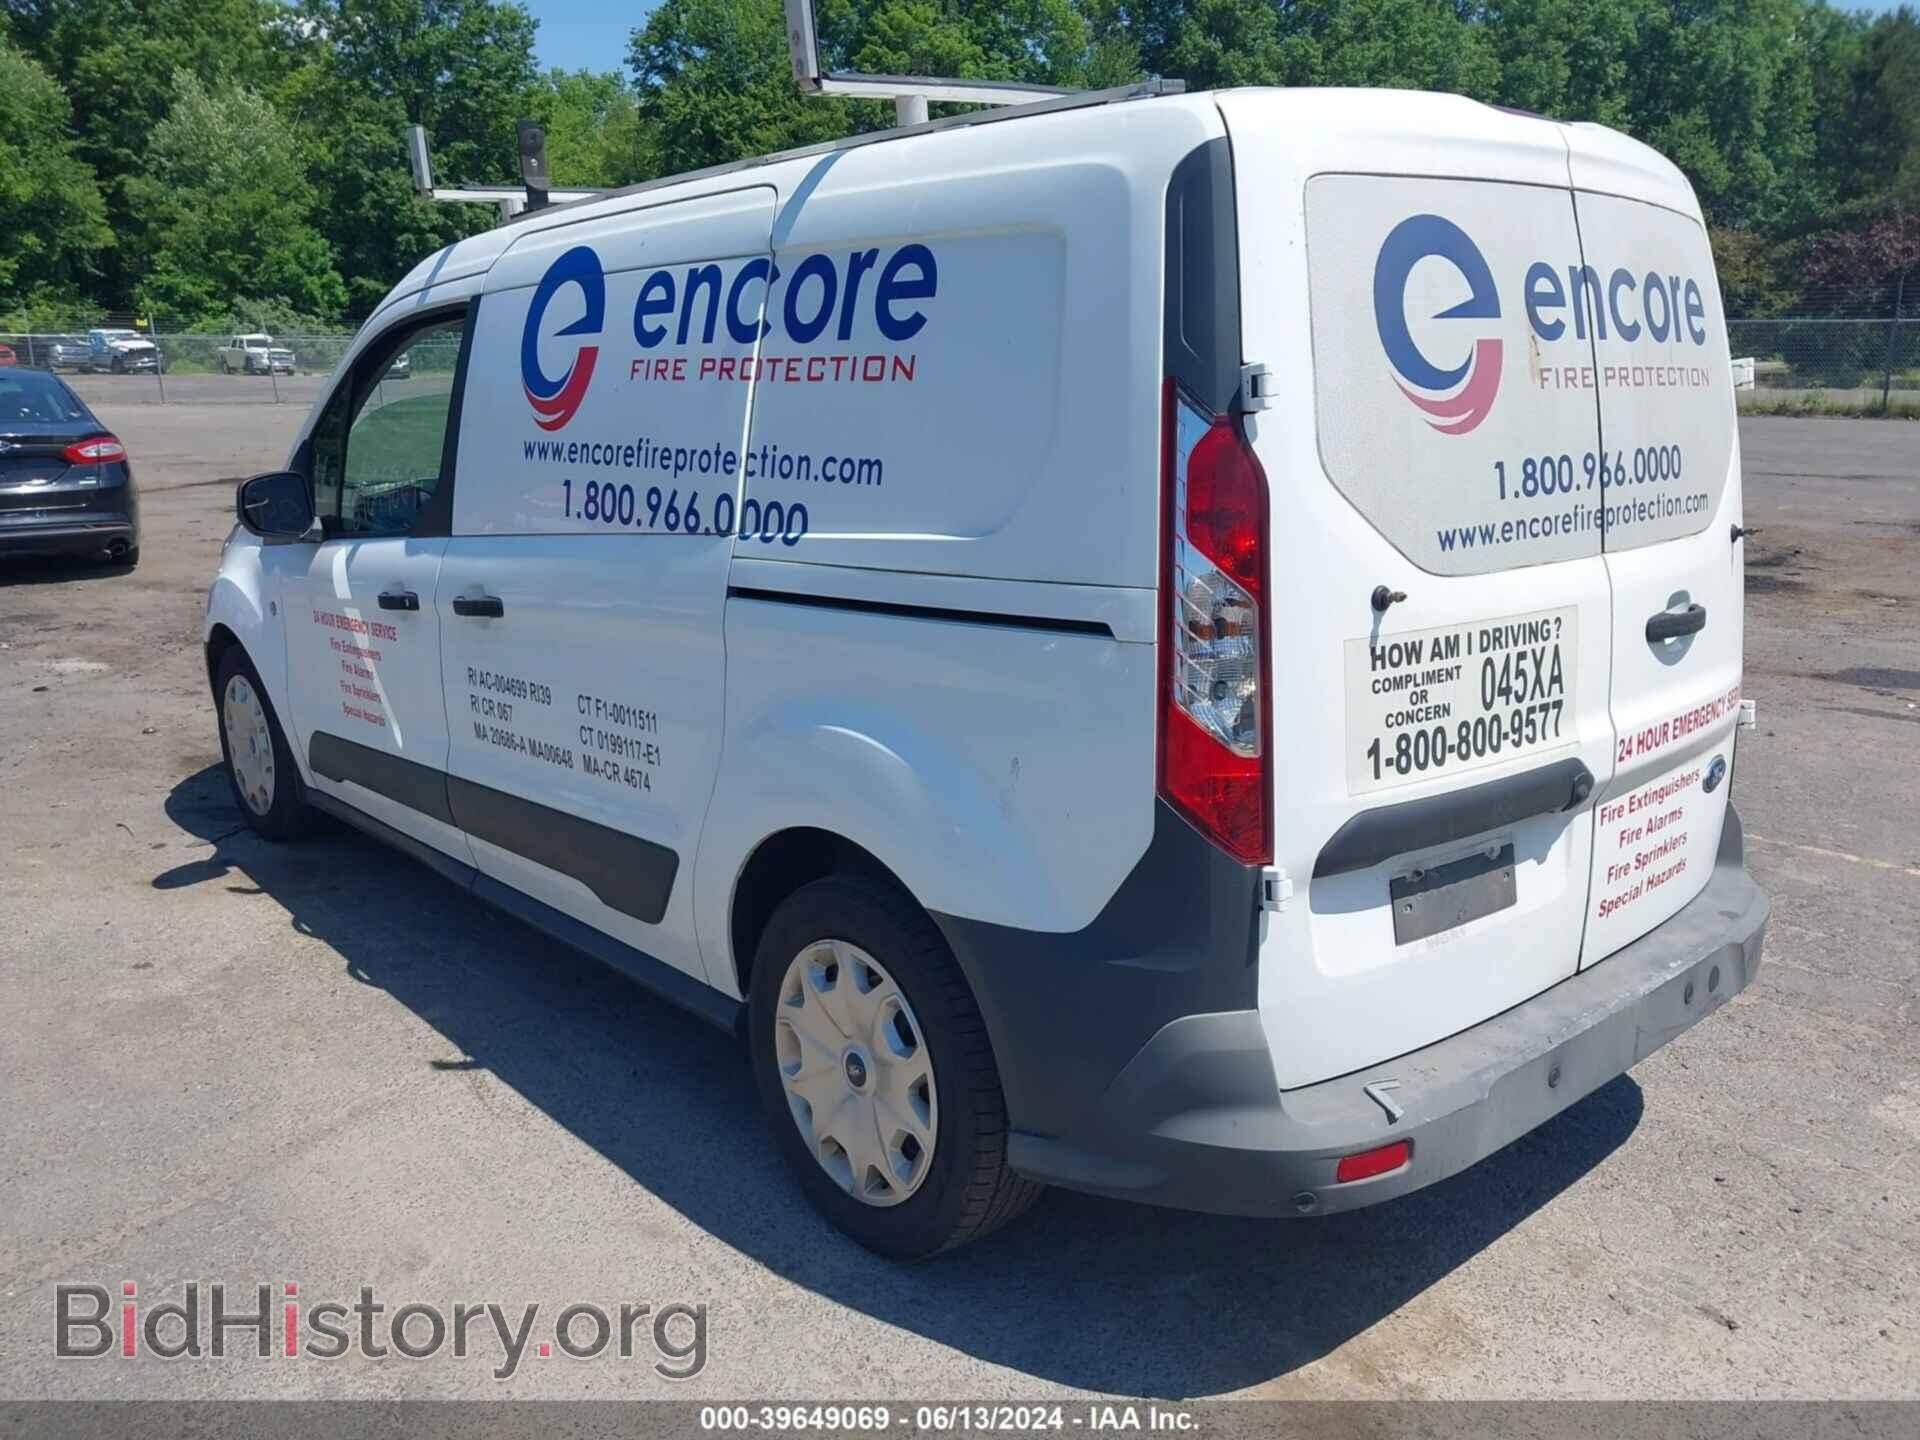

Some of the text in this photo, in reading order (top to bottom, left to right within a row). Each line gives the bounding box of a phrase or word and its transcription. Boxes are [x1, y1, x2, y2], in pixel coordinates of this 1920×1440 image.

[633, 243, 937, 349] encore
[1524, 262, 1706, 345] encore
[630, 355, 916, 382] FIRE PROTECTION
[1539, 366, 1710, 390] FIRE PROTECTION
[523, 438, 883, 486] www.encorefireprotection.com
[1494, 444, 1681, 500] 1.800.966.0000
[562, 479, 808, 546] 1.800.966.0000
[1438, 491, 1708, 552] www.encorefireprotection.com
[371, 622, 397, 642] SERVICE
[1371, 640, 1422, 671] HOW
[1430, 634, 1460, 662] AM
[1468, 632, 1472, 655] I
[468, 667, 477, 686] RI
[1372, 666, 1462, 695] COMPLIMENT
[1481, 644, 1564, 711] 045XA
[470, 694, 480, 713] RI
[482, 697, 496, 718] CR
[578, 694, 657, 734] CT F1-0011511
[1385, 703, 1451, 728] CONCERN
[1410, 690, 1428, 706] OR
[474, 720, 489, 742] MA
[580, 725, 594, 747] CT
[1367, 699, 1564, 780] 1-800-800-9577
[1618, 735, 1633, 762] 24
[1637, 722, 1669, 755] HOUR
[1672, 697, 1725, 740] EMERGENCY
[583, 753, 651, 792] MA-CR 4674
[1600, 805, 1625, 827] Fire
[1628, 768, 1700, 814] Extinguishers
[1619, 806, 1683, 849] Fire Alarms
[1607, 831, 1688, 885] Fire Sprinklers
[1598, 858, 1687, 919] Special Hazards
